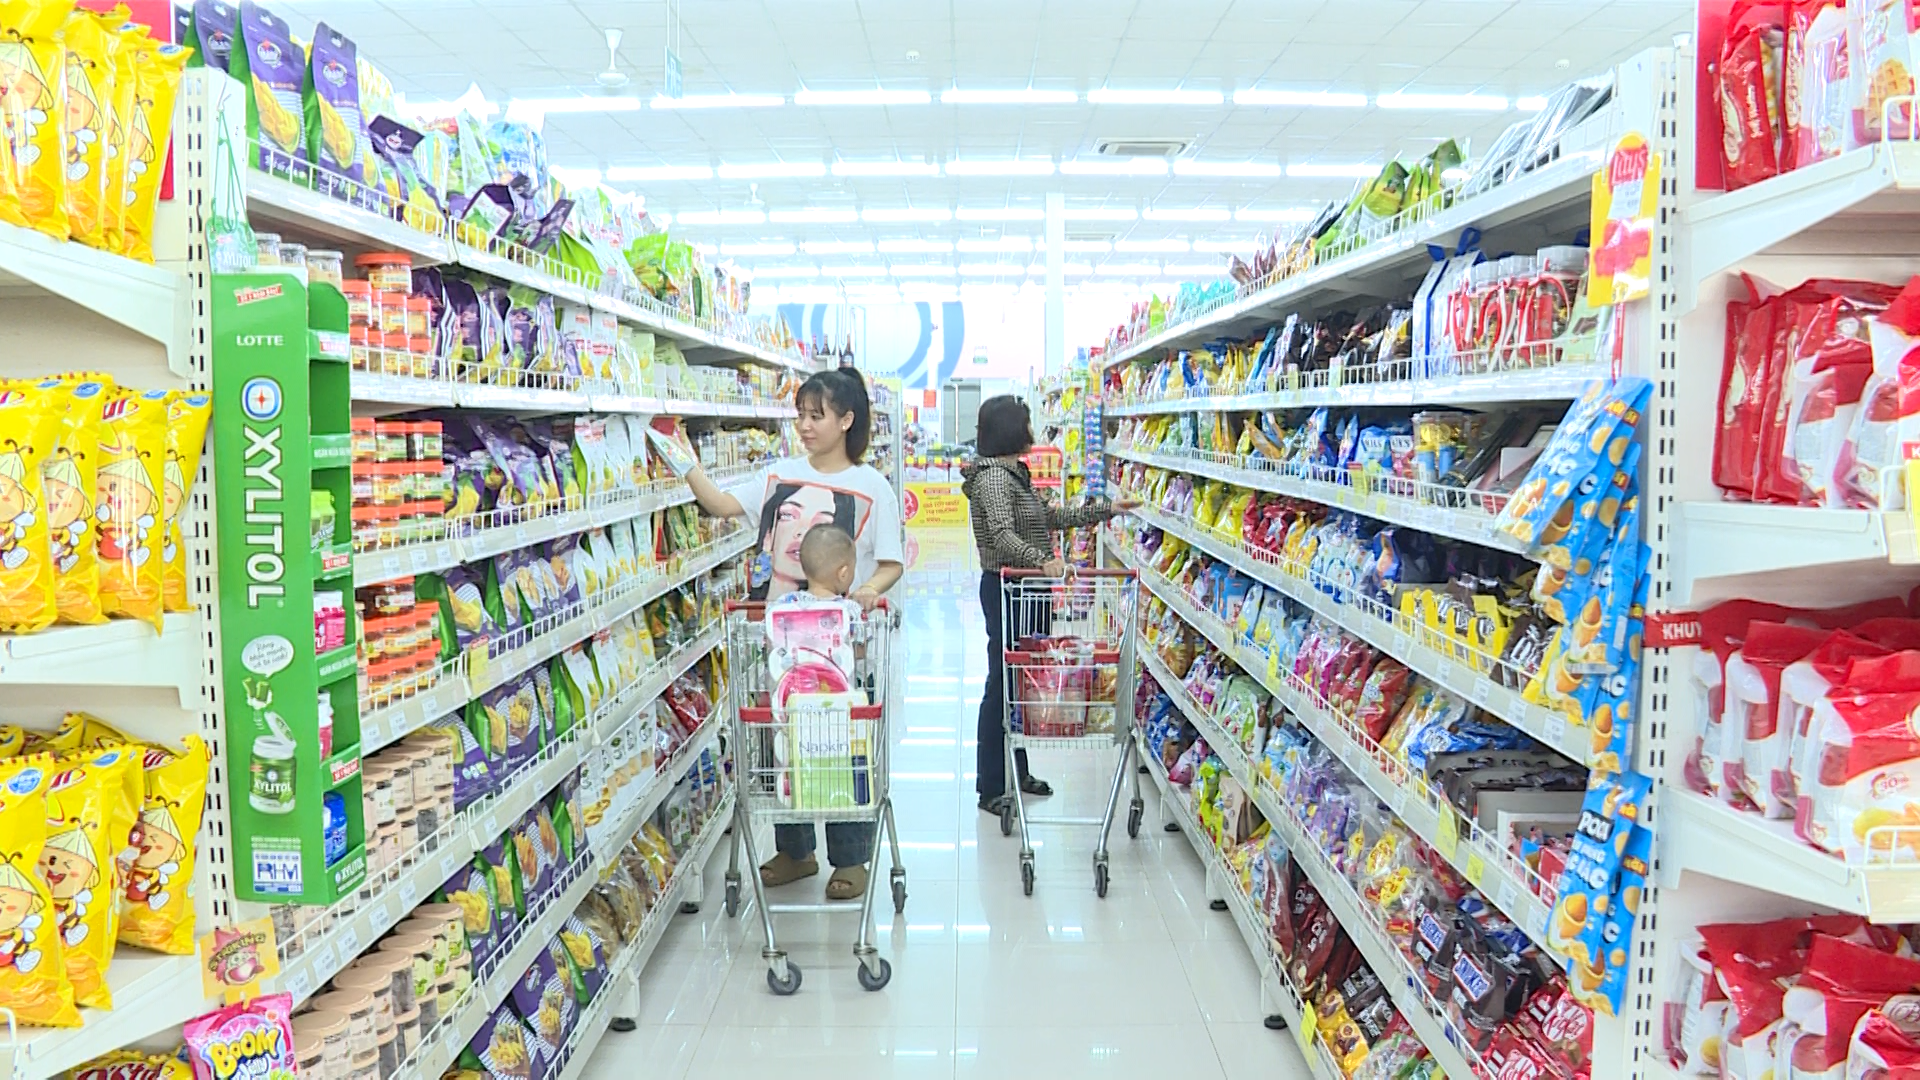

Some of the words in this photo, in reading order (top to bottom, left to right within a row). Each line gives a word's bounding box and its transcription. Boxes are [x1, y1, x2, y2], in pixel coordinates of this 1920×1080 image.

[236, 335, 284, 346] LOTTE
[243, 424, 285, 609] XYLITOL
[799, 740, 849, 753] Napkin
[254, 780, 292, 793] XYLITOL
[257, 862, 299, 881] RHM
